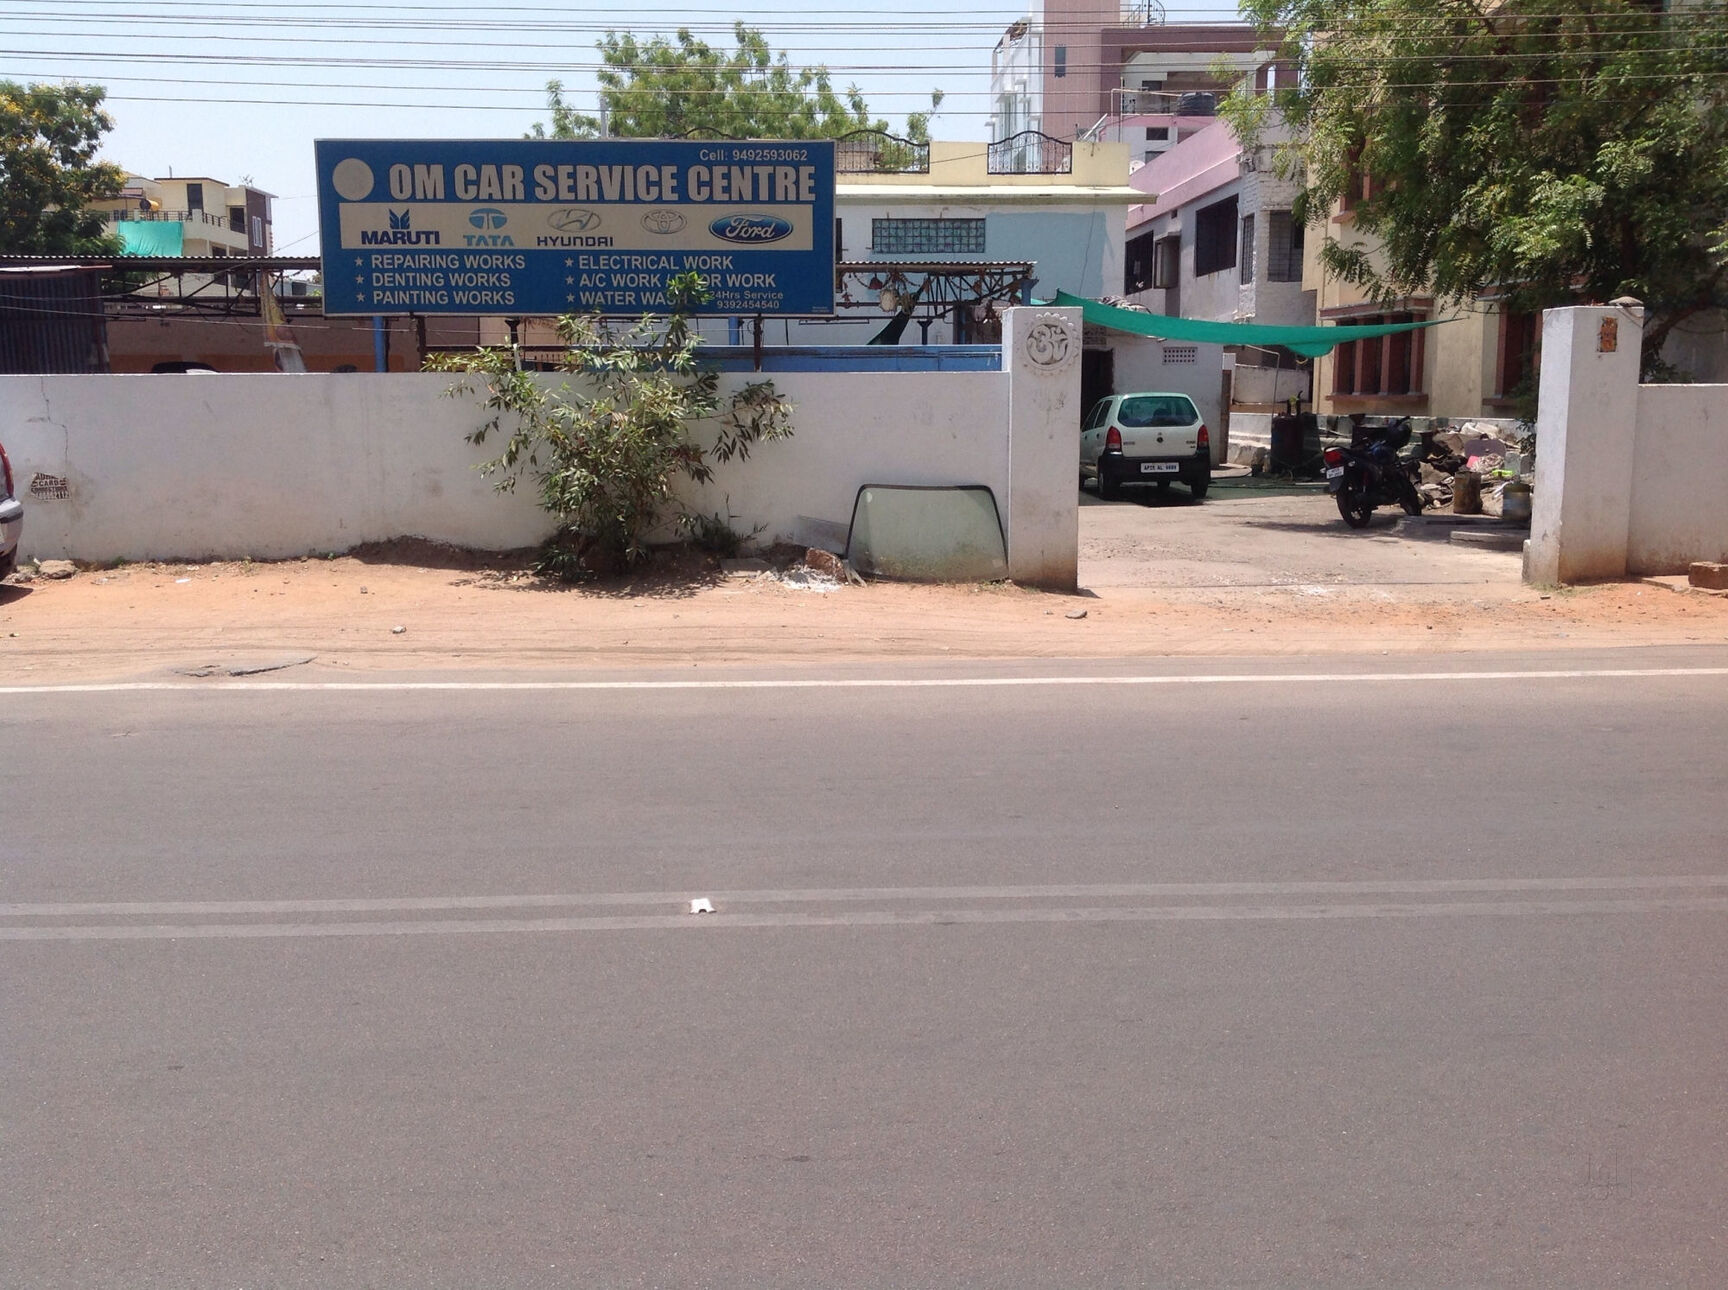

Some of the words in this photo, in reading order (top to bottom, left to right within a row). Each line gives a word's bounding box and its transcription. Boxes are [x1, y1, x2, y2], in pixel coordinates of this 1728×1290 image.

[700, 150, 728, 161] Cell:
[733, 150, 808, 161] 9492593062
[389, 163, 445, 200] OM
[454, 163, 525, 200] CAR
[533, 163, 679, 201] SERVICE
[687, 165, 816, 201] CENTRE
[725, 215, 776, 238] Ford
[361, 231, 440, 245] MARUTI
[463, 235, 514, 247] TATA
[537, 236, 613, 247] HYUNDAI
[371, 255, 459, 269] REPAIRING
[464, 255, 526, 269] WORKS
[579, 256, 680, 270] ELECTRICAL
[684, 256, 733, 270] WORK
[372, 272, 445, 287] DENTING
[449, 273, 511, 287] WORKS
[579, 274, 606, 288] A/C
[611, 274, 660, 288] WORK
[726, 274, 776, 288] WORK
[373, 290, 448, 305] PAINTING
[453, 290, 515, 305] WORKS
[580, 291, 636, 305] WATER
[743, 290, 784, 300] Service
